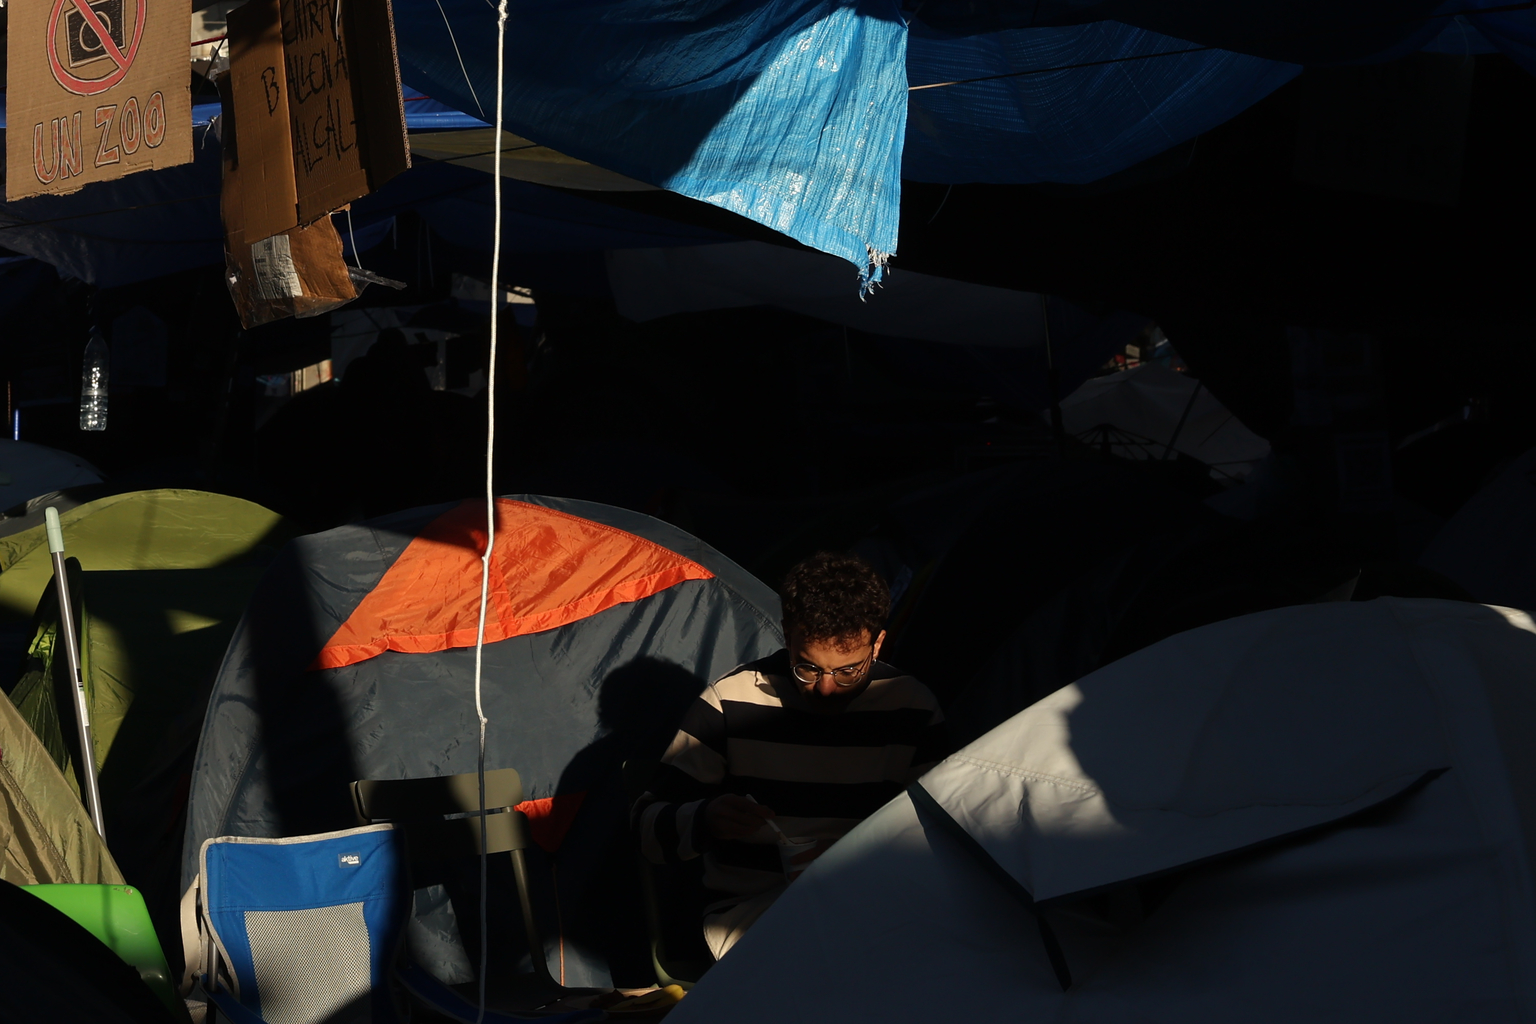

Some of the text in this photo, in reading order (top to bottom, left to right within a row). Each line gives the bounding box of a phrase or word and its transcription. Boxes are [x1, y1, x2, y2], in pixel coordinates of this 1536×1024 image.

[260, 35, 349, 117] BALLENA
[32, 90, 168, 185] UN ZOO
